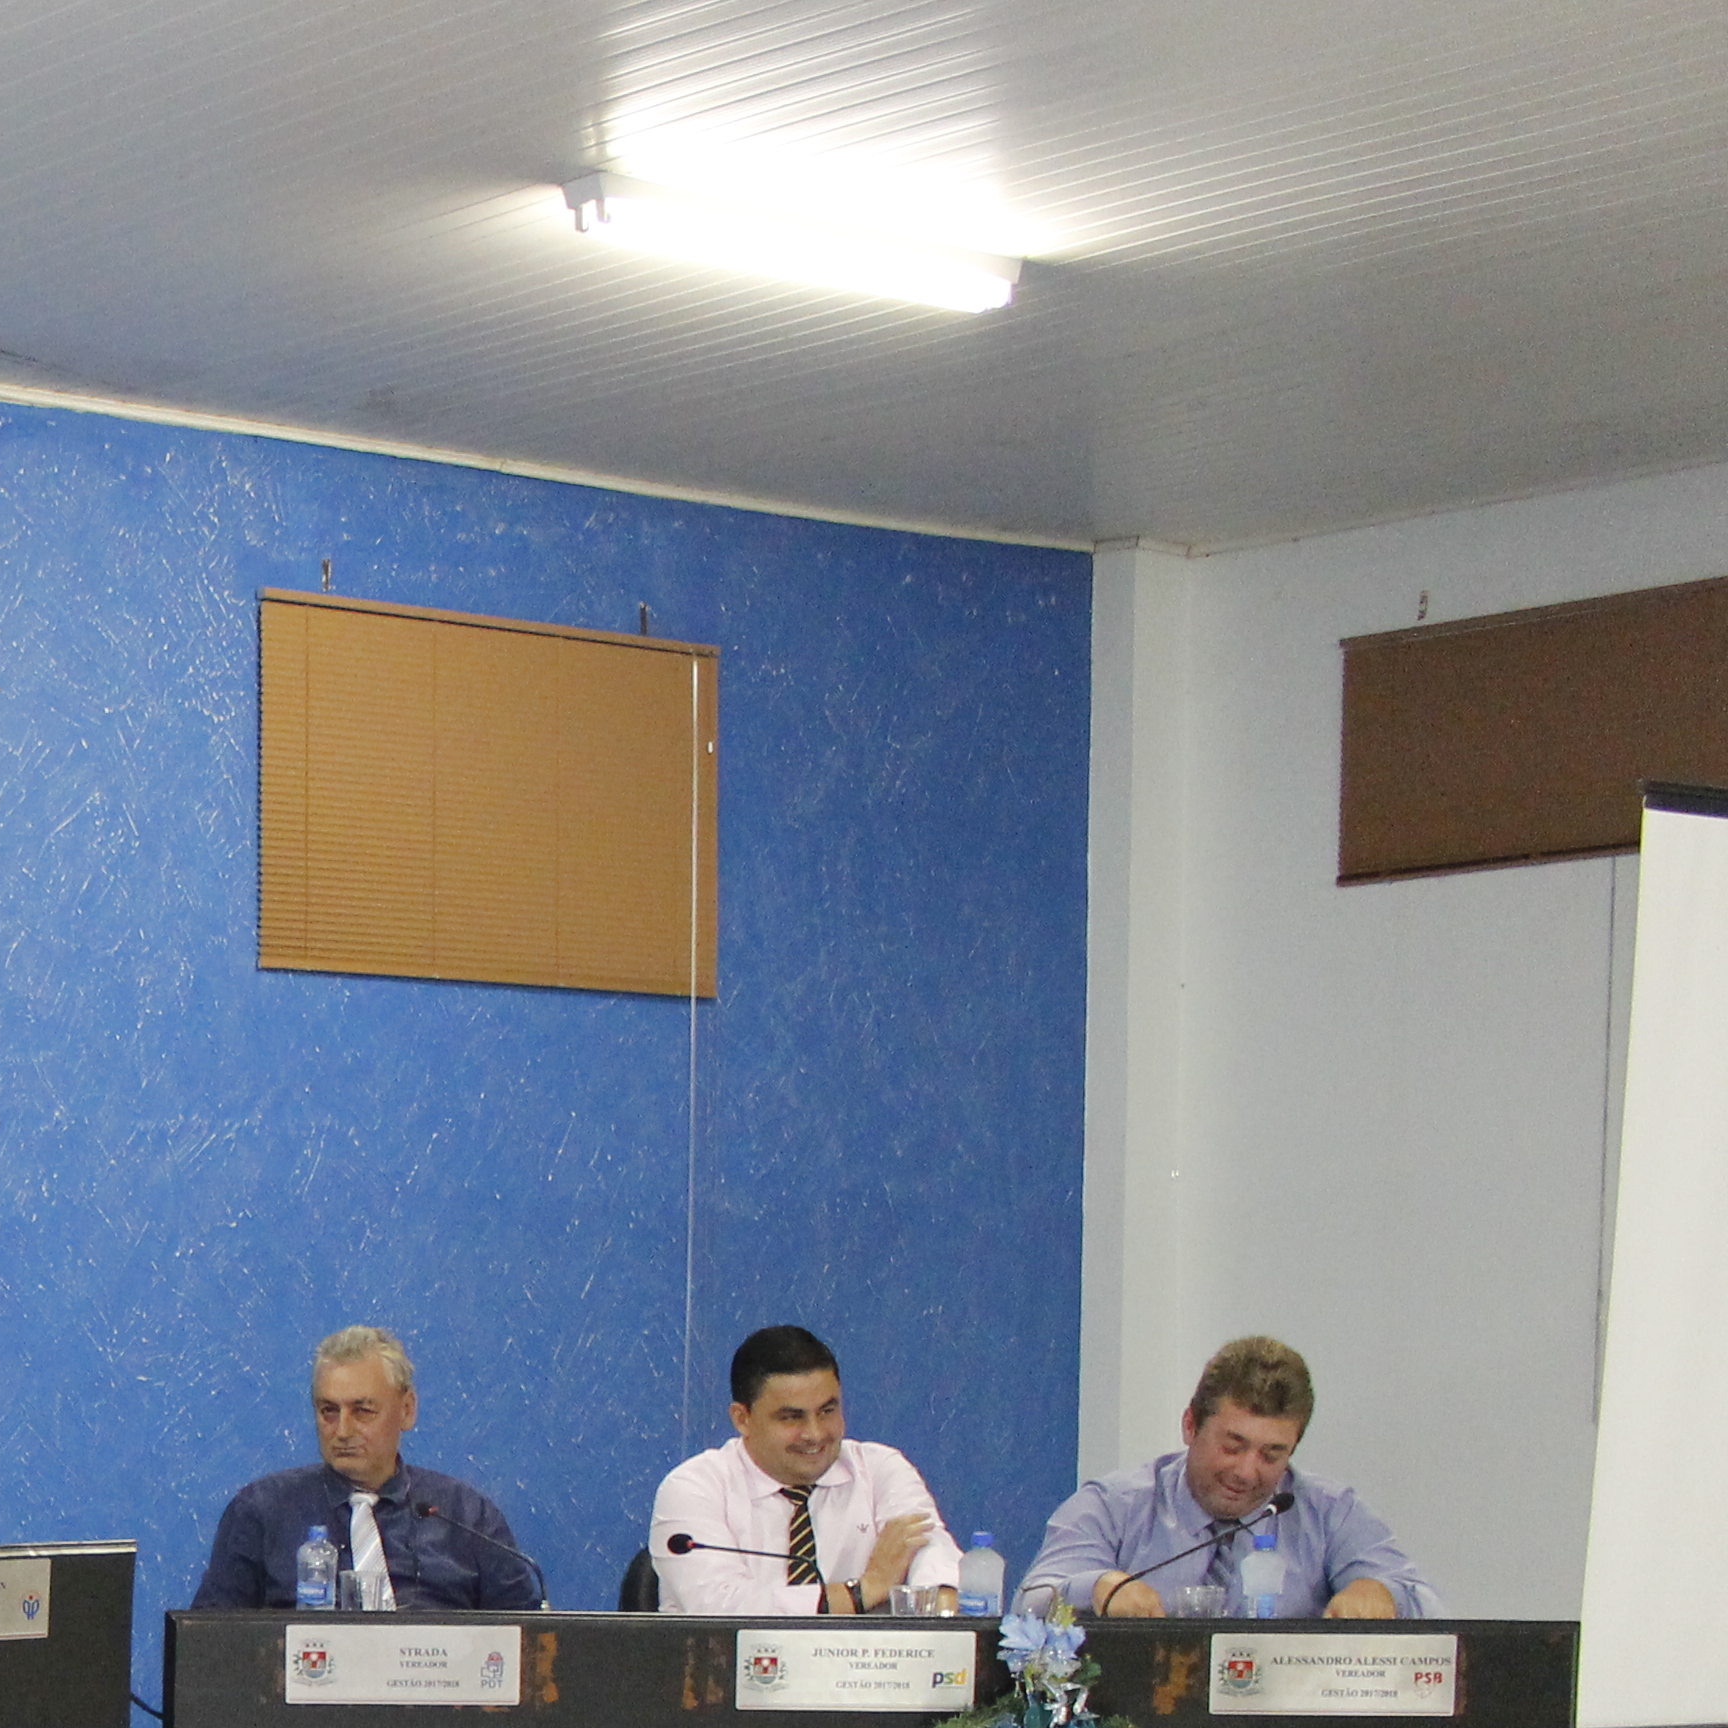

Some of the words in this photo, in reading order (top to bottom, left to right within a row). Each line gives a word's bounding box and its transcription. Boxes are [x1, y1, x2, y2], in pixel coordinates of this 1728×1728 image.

[399, 1647, 448, 1657] STRADA
[812, 1648, 858, 1658] JUNIOR
[861, 1648, 870, 1658] P.
[874, 1649, 935, 1658] FEDERICE
[848, 1662, 898, 1670] VEREADOR
[1270, 1656, 1352, 1666] ALESSANDRO
[1356, 1656, 1397, 1666] ALESSI
[1400, 1656, 1452, 1666] CAMPOS
[932, 1668, 968, 1689] psd
[1335, 1669, 1386, 1678] VEREADOR
[1414, 1671, 1443, 1684] PSB
[386, 1679, 422, 1688] GESTÃO
[481, 1679, 503, 1688] PDT
[835, 1680, 872, 1689] GESTÃO
[1321, 1687, 1358, 1698] GESTÃO
